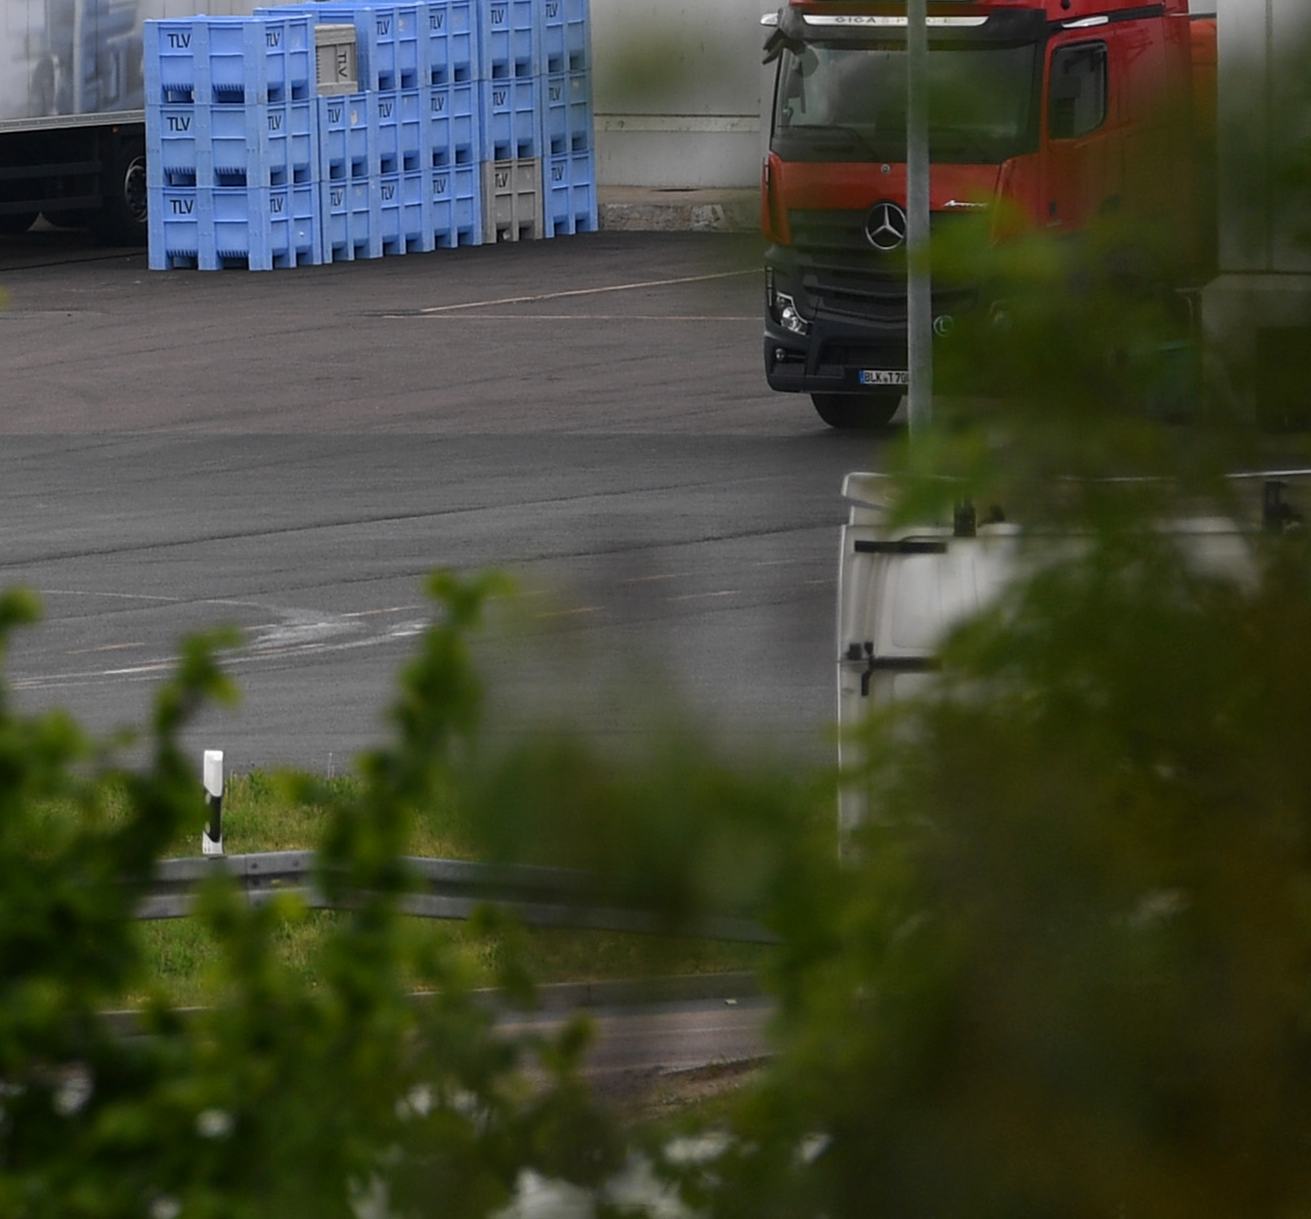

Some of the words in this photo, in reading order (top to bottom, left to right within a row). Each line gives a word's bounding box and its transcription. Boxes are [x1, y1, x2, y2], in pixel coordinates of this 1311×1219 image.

[491, 9, 504, 24] TLV
[545, 3, 558, 17] TLV
[376, 20, 390, 35] TLV
[429, 14, 443, 29] TLV
[167, 34, 191, 48] TLV
[266, 33, 280, 47] TLV
[337, 51, 348, 77] TLV
[492, 91, 506, 106] TLV
[549, 87, 561, 101] TLV
[379, 103, 392, 118] TLV
[431, 97, 444, 112] TLV
[268, 116, 282, 130] TLV
[328, 109, 341, 123] TLV
[167, 117, 191, 131] TLV
[495, 173, 508, 187] TLV
[551, 166, 564, 181] TLV
[381, 186, 394, 201] TLV
[433, 179, 446, 194] TLV
[170, 199, 194, 214] TLV
[270, 198, 283, 213] TLV
[330, 191, 343, 207] TLV
